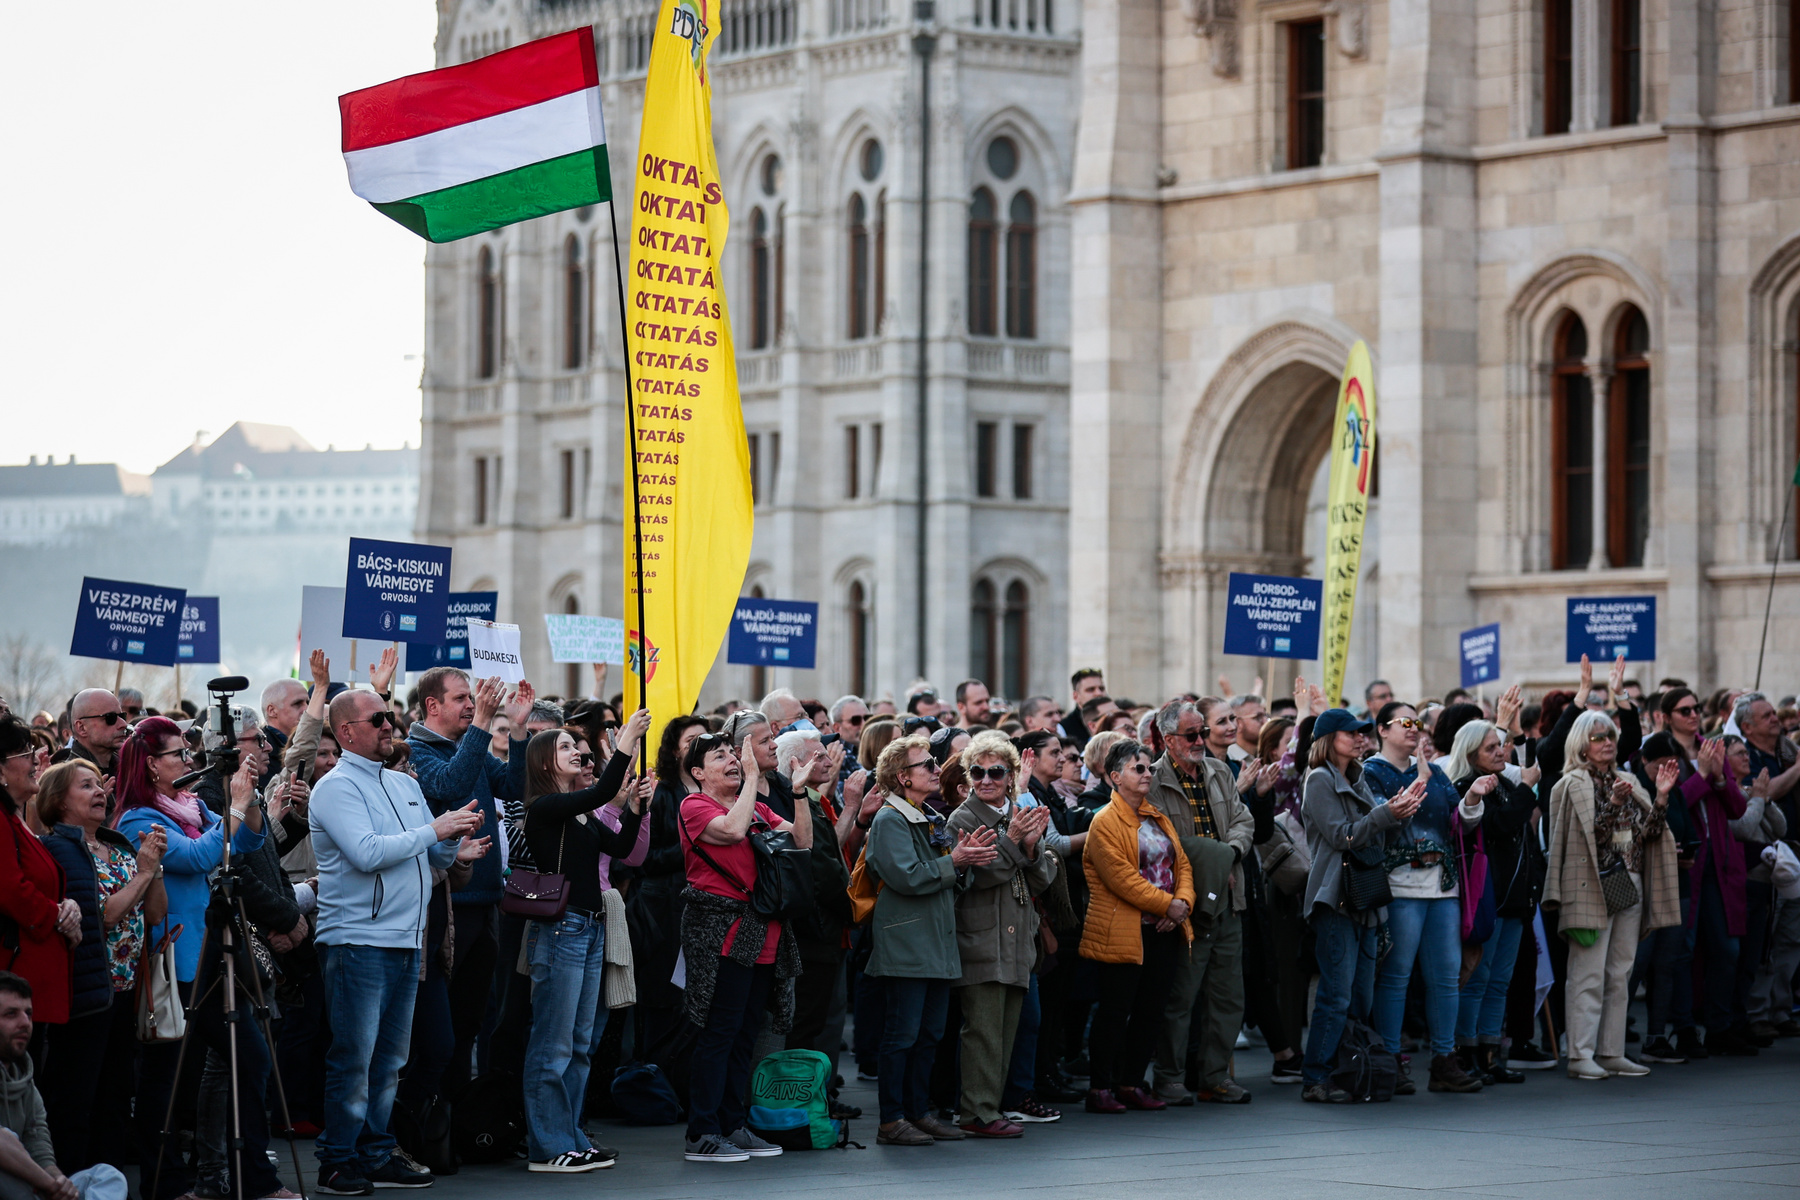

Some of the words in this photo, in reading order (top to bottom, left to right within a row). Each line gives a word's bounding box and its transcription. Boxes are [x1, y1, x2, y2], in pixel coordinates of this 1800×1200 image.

[638, 494, 673, 506] ATÁS
[357, 552, 443, 577] BÁCS-KISKUN
[365, 573, 434, 594] VÁRMEGYE
[1252, 583, 1299, 596] BORSOD-
[89, 589, 177, 614] VESZPRÉM
[381, 592, 417, 604] ORVOSAI
[1233, 594, 1317, 611] ABAÚJ-ZEMPLÉN
[447, 601, 492, 614] LÓGUSOK
[1246, 608, 1302, 623] VÁRMEGYE
[95, 607, 166, 627] VÁRMEGYE
[736, 608, 812, 624] HAJDÚ-BIHAR
[109, 622, 146, 635] ORVOSAI
[743, 621, 803, 637] VÁRMEGYE
[1256, 621, 1291, 632] ORVOSAI
[473, 648, 519, 665] BUDAKESZI
[754, 1072, 815, 1101] VANS
